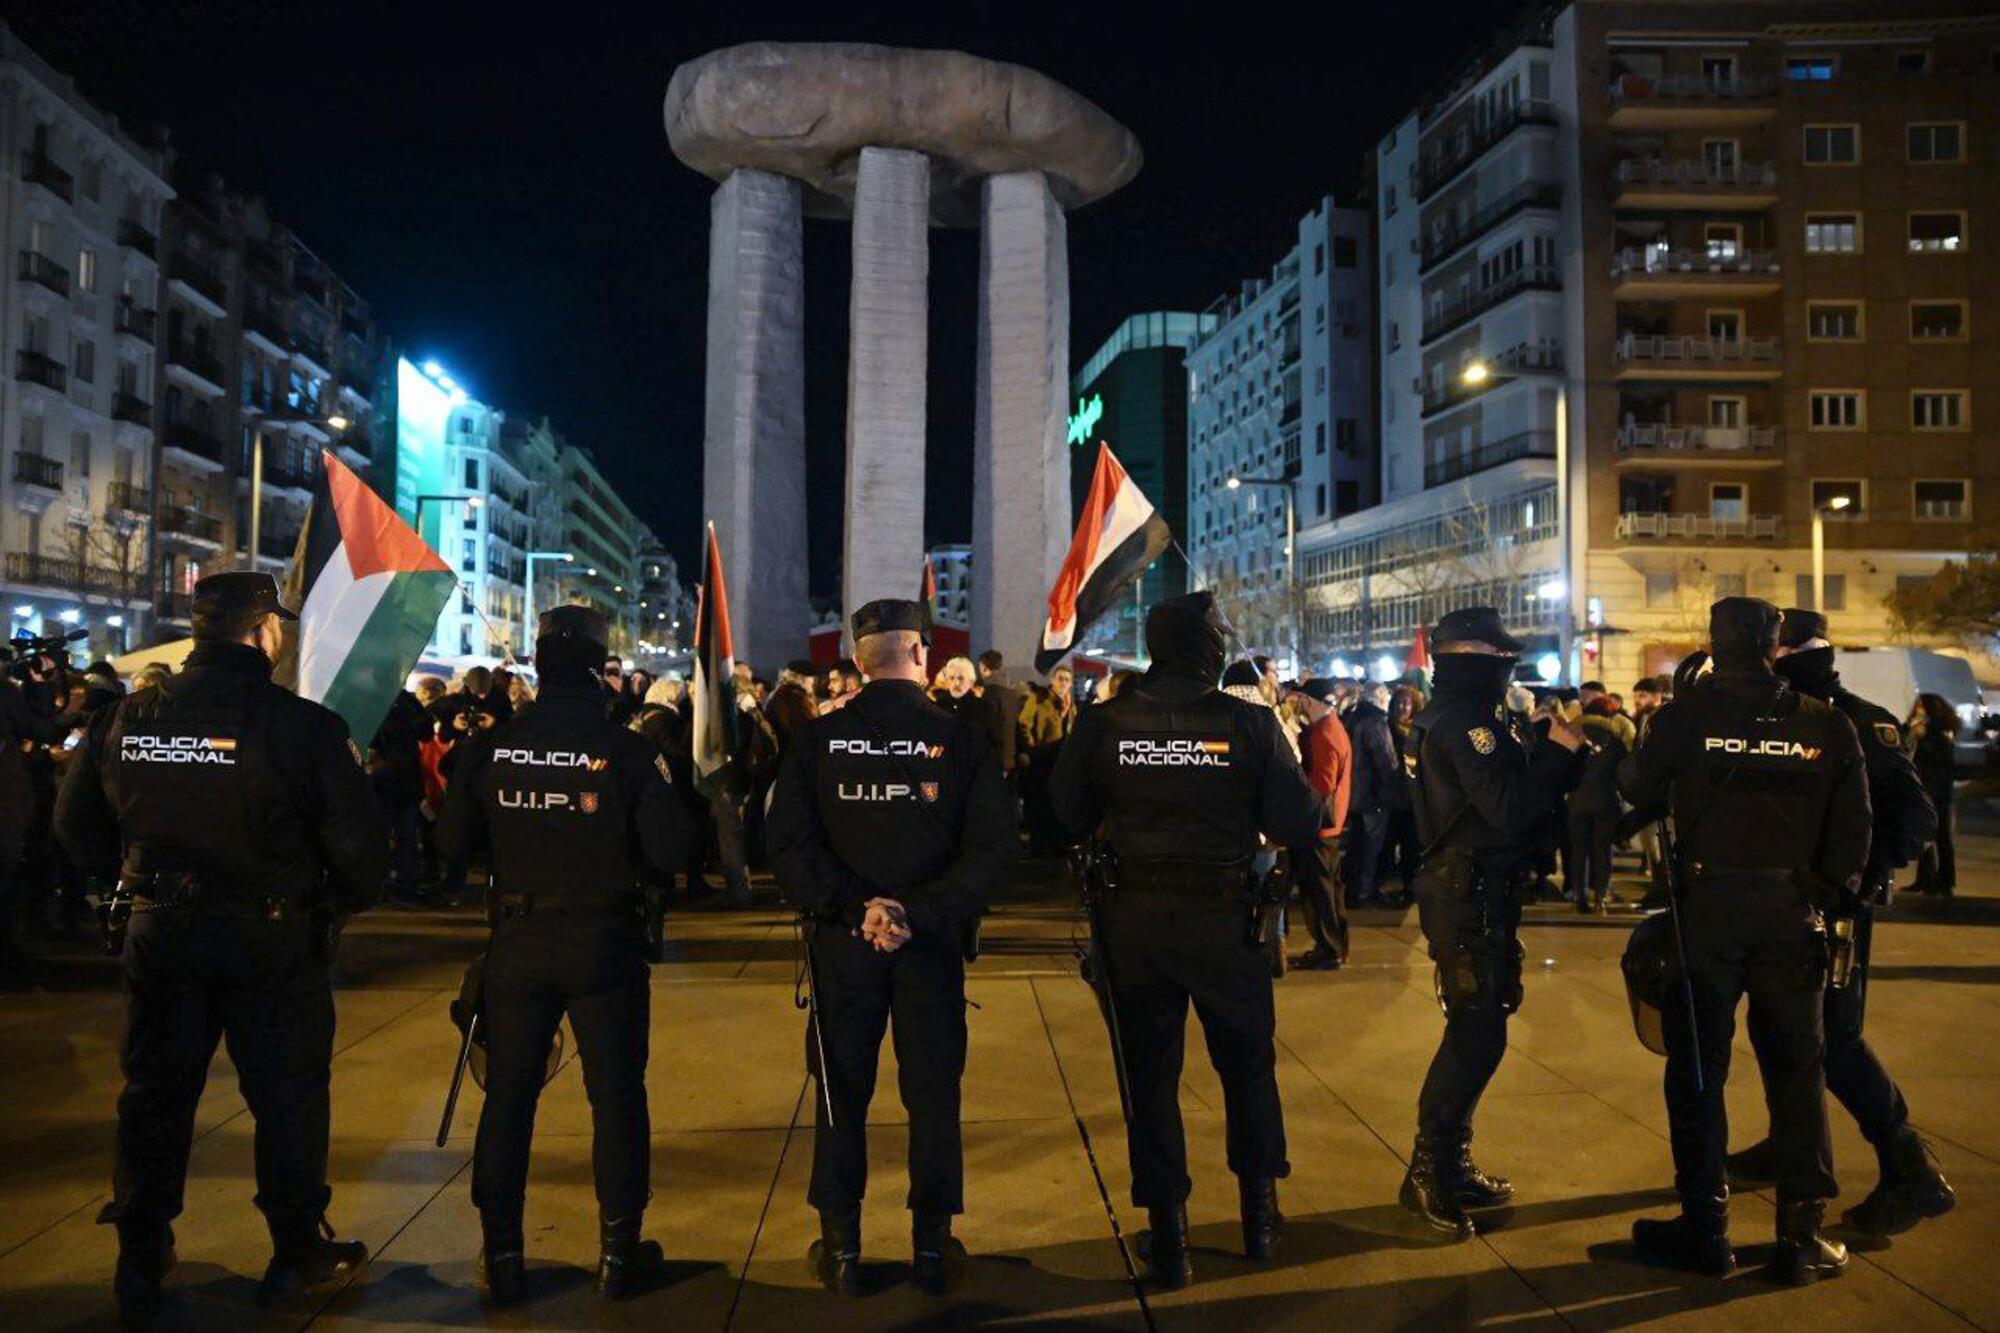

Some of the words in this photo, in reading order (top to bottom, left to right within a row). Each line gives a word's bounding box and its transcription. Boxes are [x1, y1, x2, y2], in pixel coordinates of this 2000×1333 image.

[121, 735, 212, 749] POLICIA
[1119, 740, 1207, 752] POLICIA
[1705, 737, 1805, 756] POLICIA
[121, 749, 235, 764] NACIONAL
[493, 748, 590, 767] POLICIA
[1119, 753, 1230, 766] NACIONAL
[498, 789, 575, 811] U.I.P.
[838, 783, 917, 801] U.I.P.
